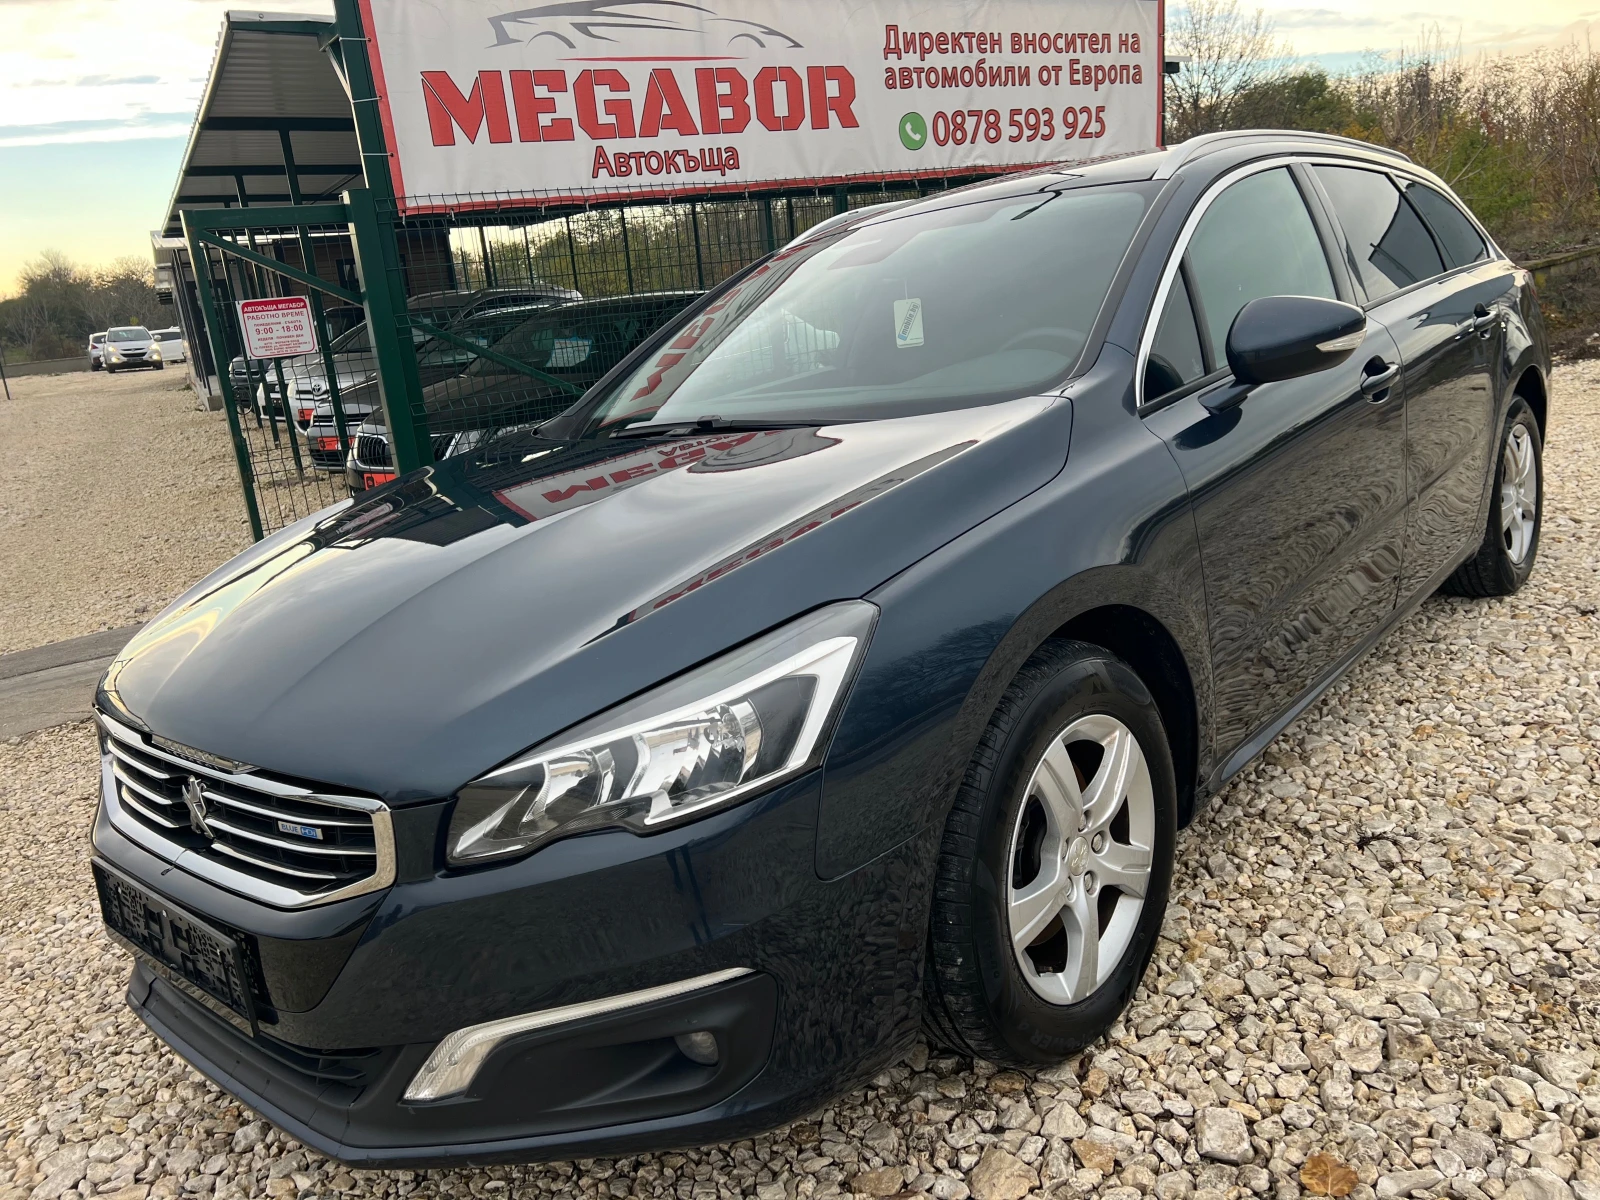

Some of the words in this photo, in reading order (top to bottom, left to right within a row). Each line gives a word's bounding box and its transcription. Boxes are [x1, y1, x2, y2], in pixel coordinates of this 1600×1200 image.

[884, 25, 1001, 61] Директен
[1010, 32, 1112, 55] вносител
[1118, 31, 1142, 54] на
[884, 58, 1031, 89] автомобили
[1038, 65, 1062, 87] от
[1069, 59, 1143, 92] Европа
[420, 65, 860, 147] MEGABOR
[932, 109, 1002, 147] 0878
[1008, 107, 1055, 143] 593
[1062, 105, 1107, 141] 925
[591, 145, 740, 178] Автокъща
[255, 327, 273, 335] 9:00
[281, 324, 303, 332] 18:00
[902, 304, 918, 335] mobile.bg
[281, 823, 298, 833] BLUE
